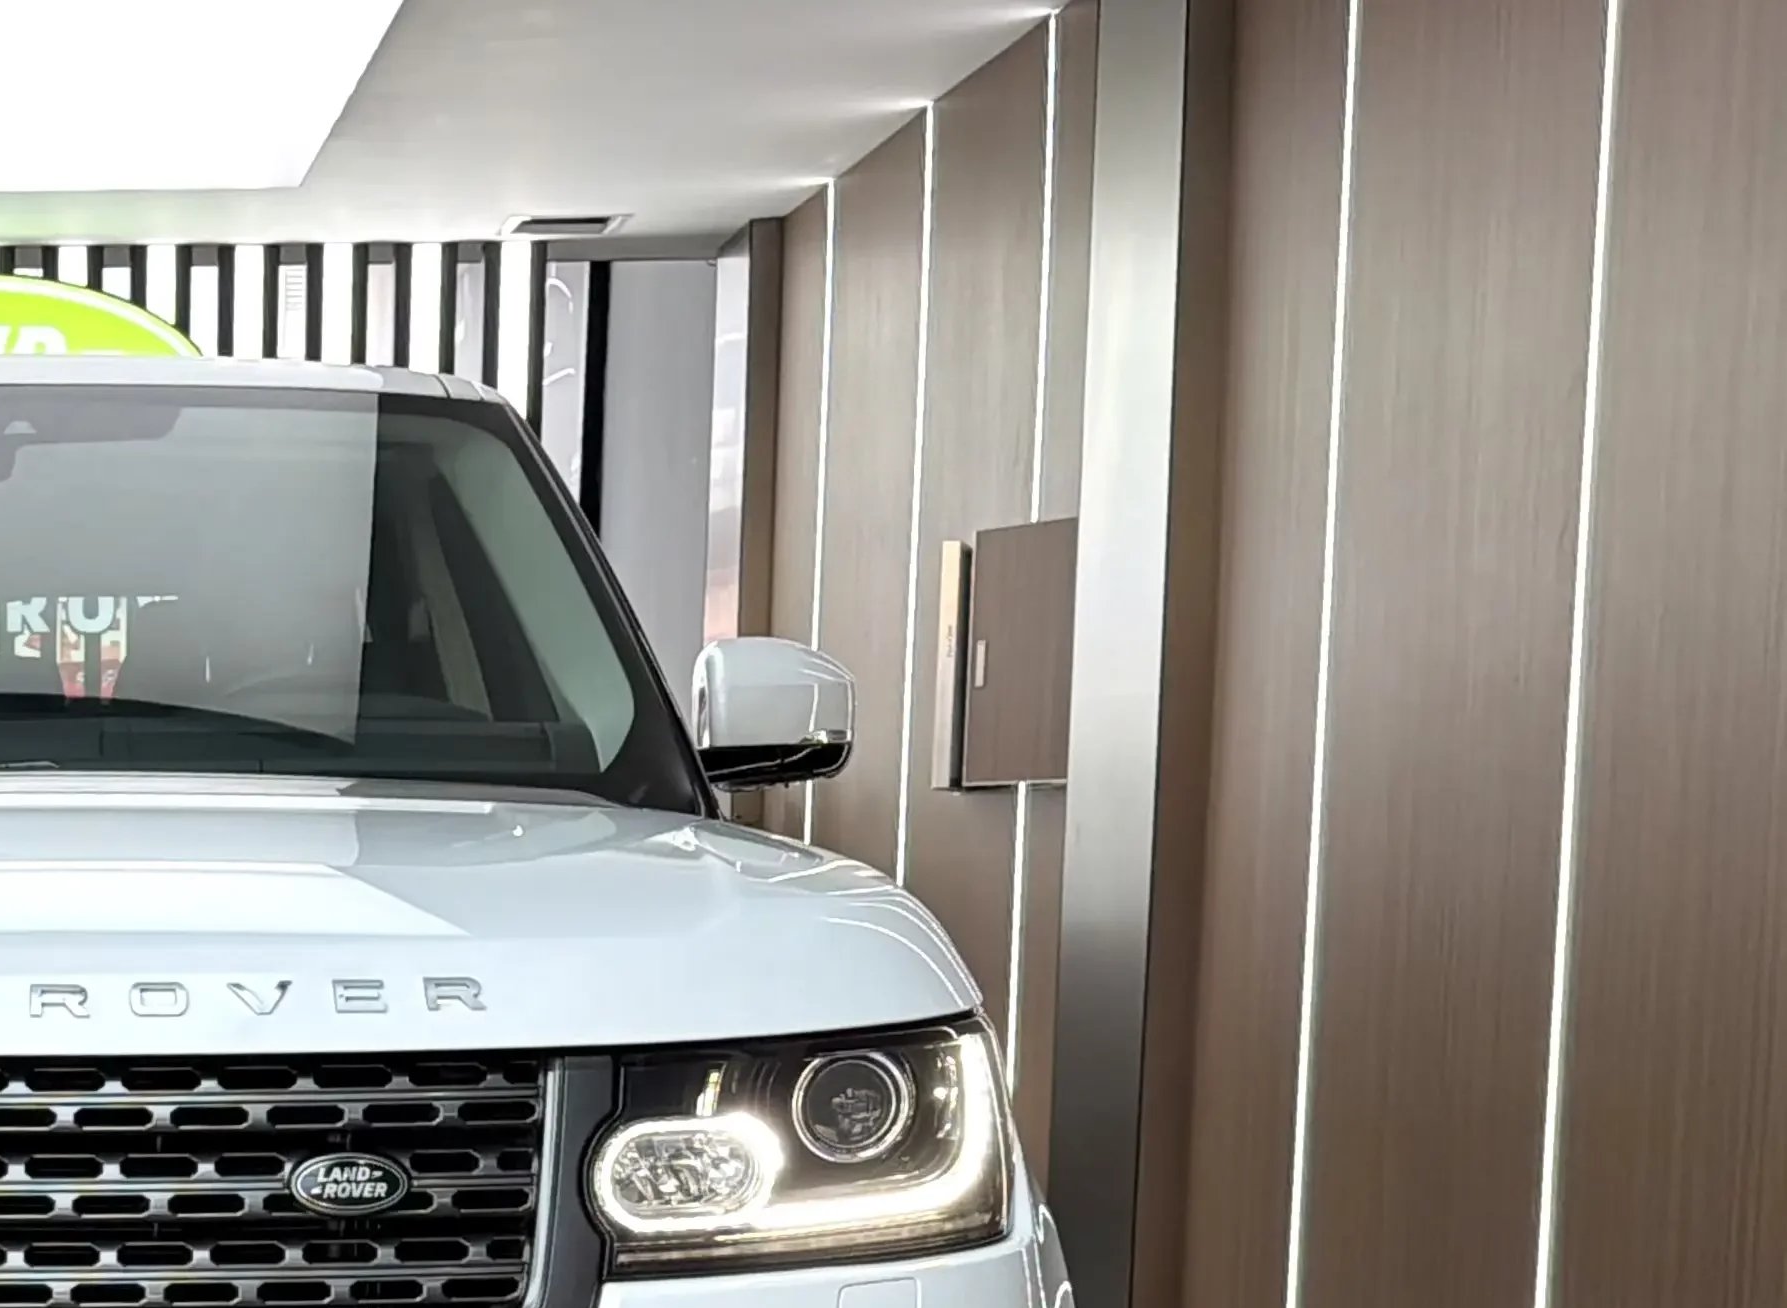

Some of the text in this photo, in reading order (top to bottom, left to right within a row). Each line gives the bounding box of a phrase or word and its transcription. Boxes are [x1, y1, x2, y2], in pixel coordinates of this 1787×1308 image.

[28, 976, 488, 1019] ROVER
[316, 1166, 371, 1183] LAND
[322, 1181, 389, 1199] ROVER
